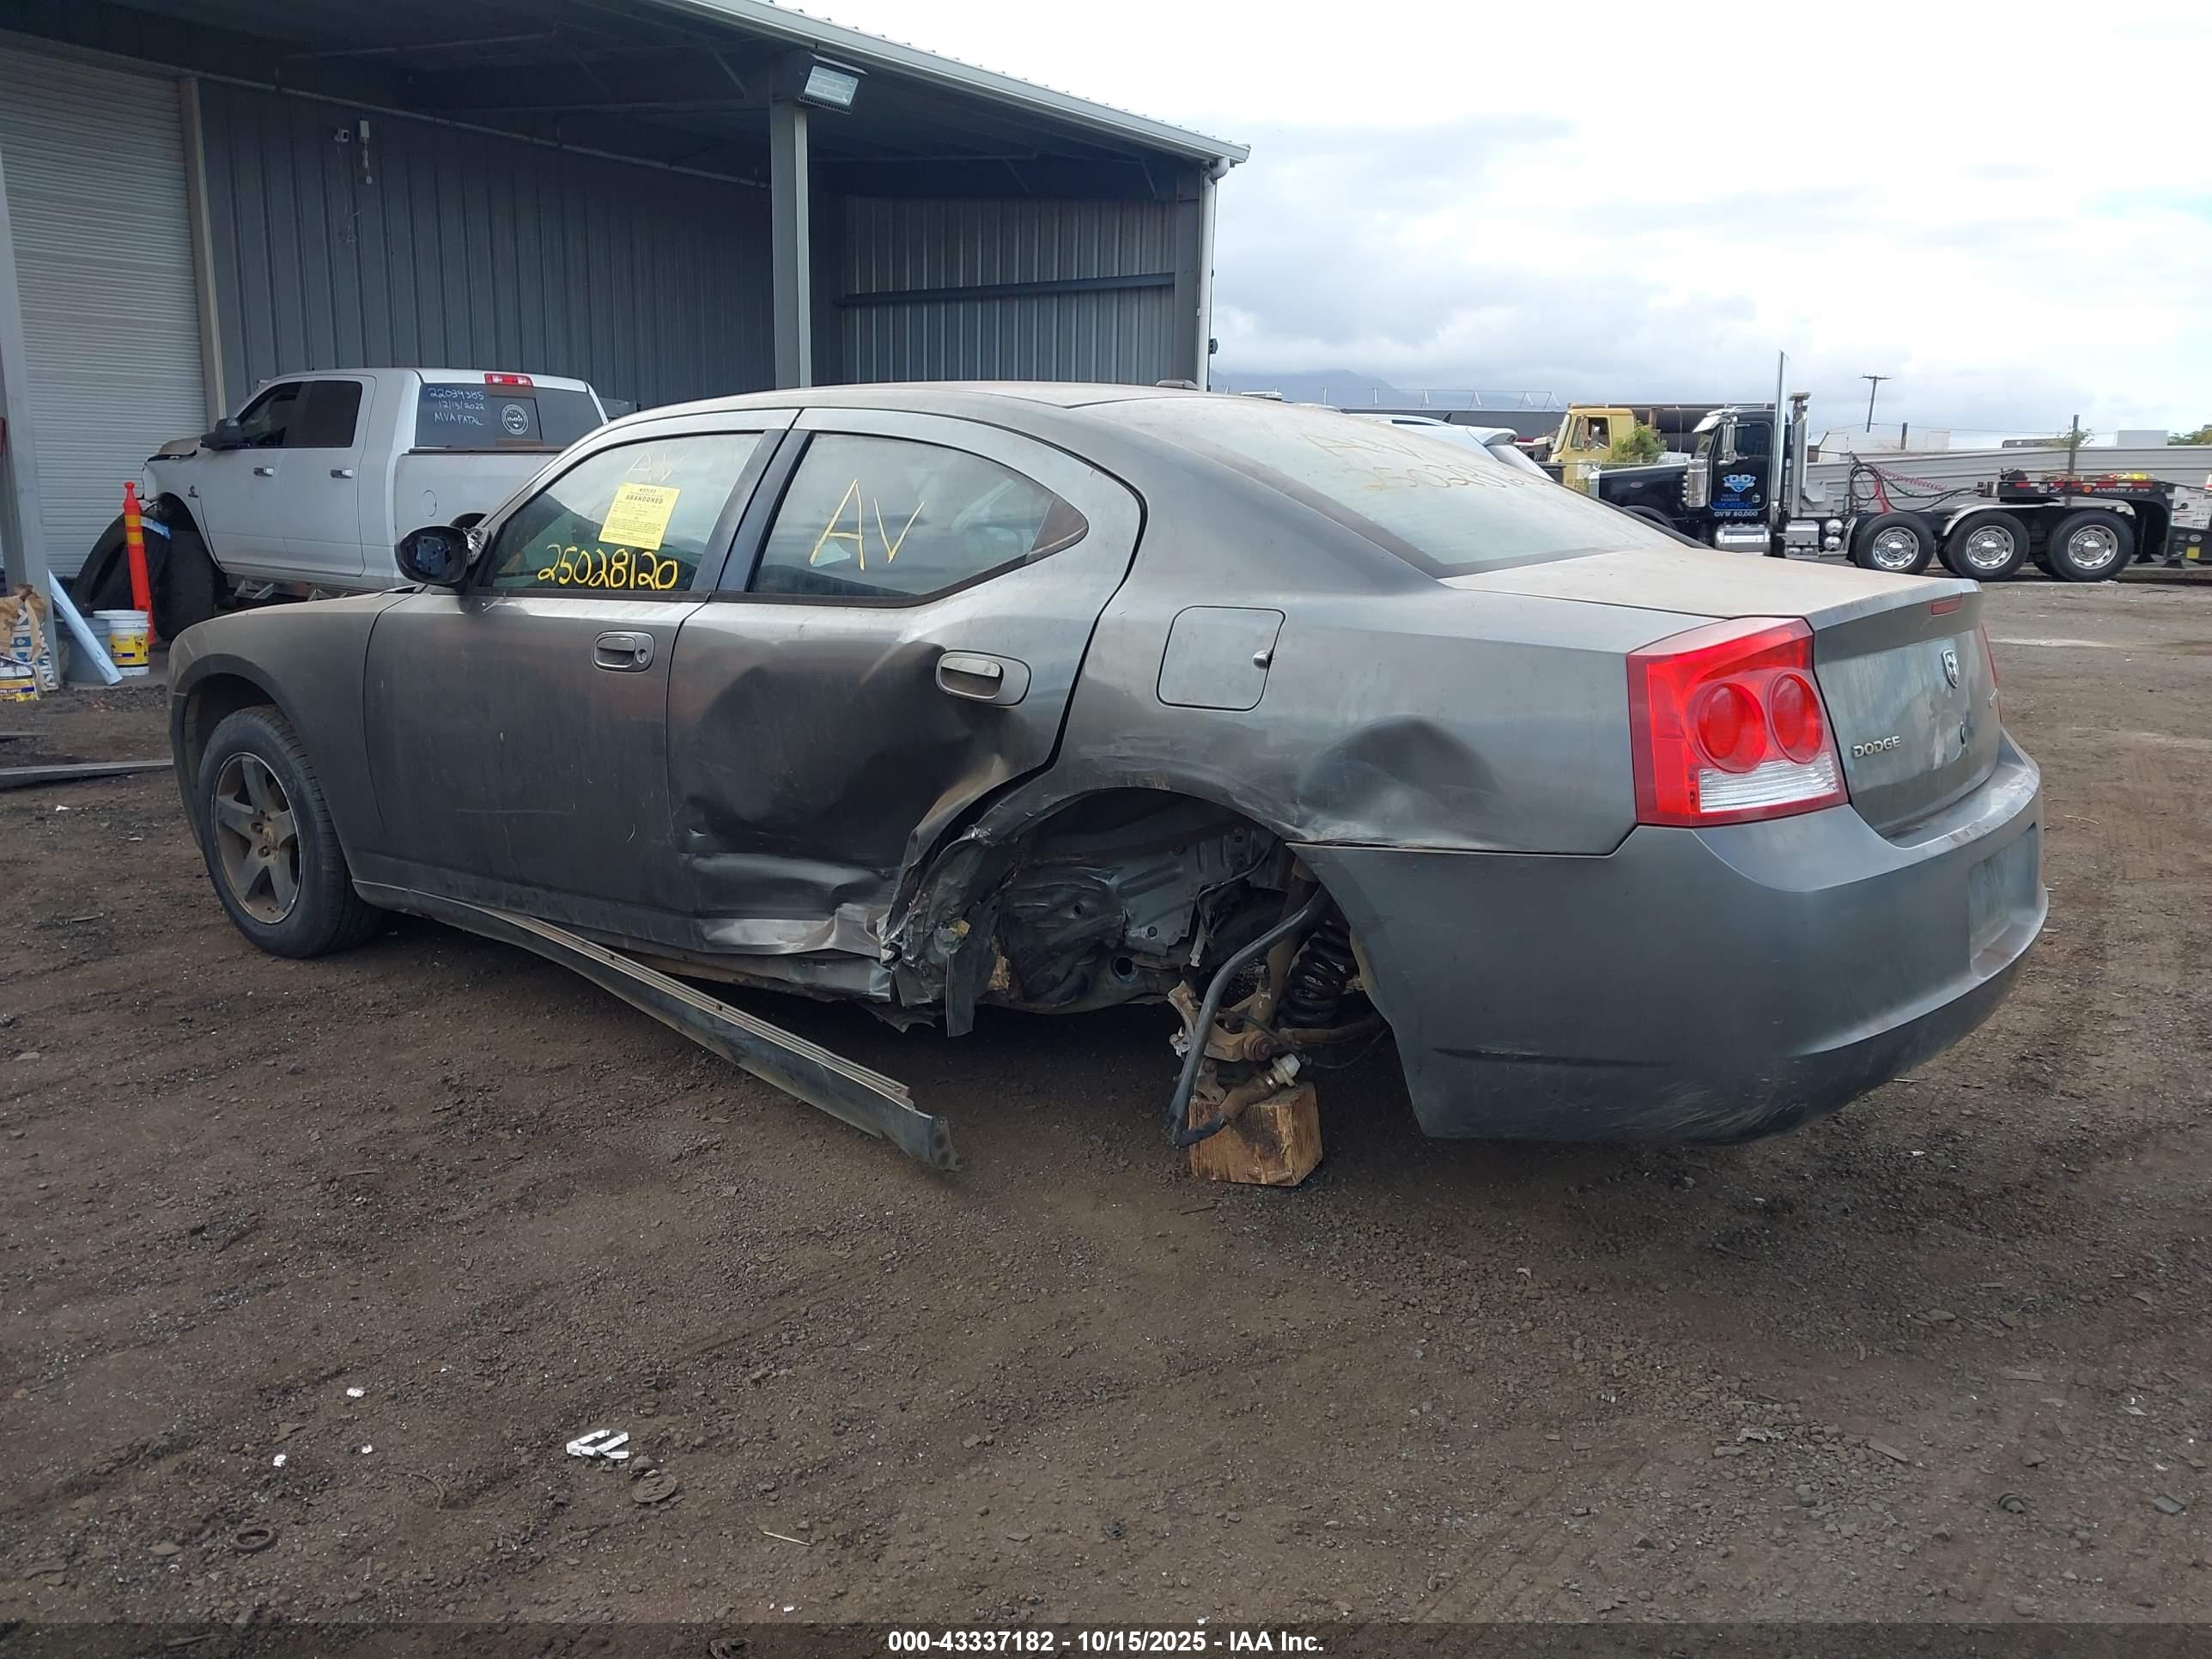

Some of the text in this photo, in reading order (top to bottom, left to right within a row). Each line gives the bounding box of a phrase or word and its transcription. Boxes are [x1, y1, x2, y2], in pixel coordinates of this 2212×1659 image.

[625, 495, 664, 504] ABANDONED
[808, 478, 926, 571] AV
[537, 544, 679, 591] 25028120
[1852, 735, 1901, 758] DODGE
